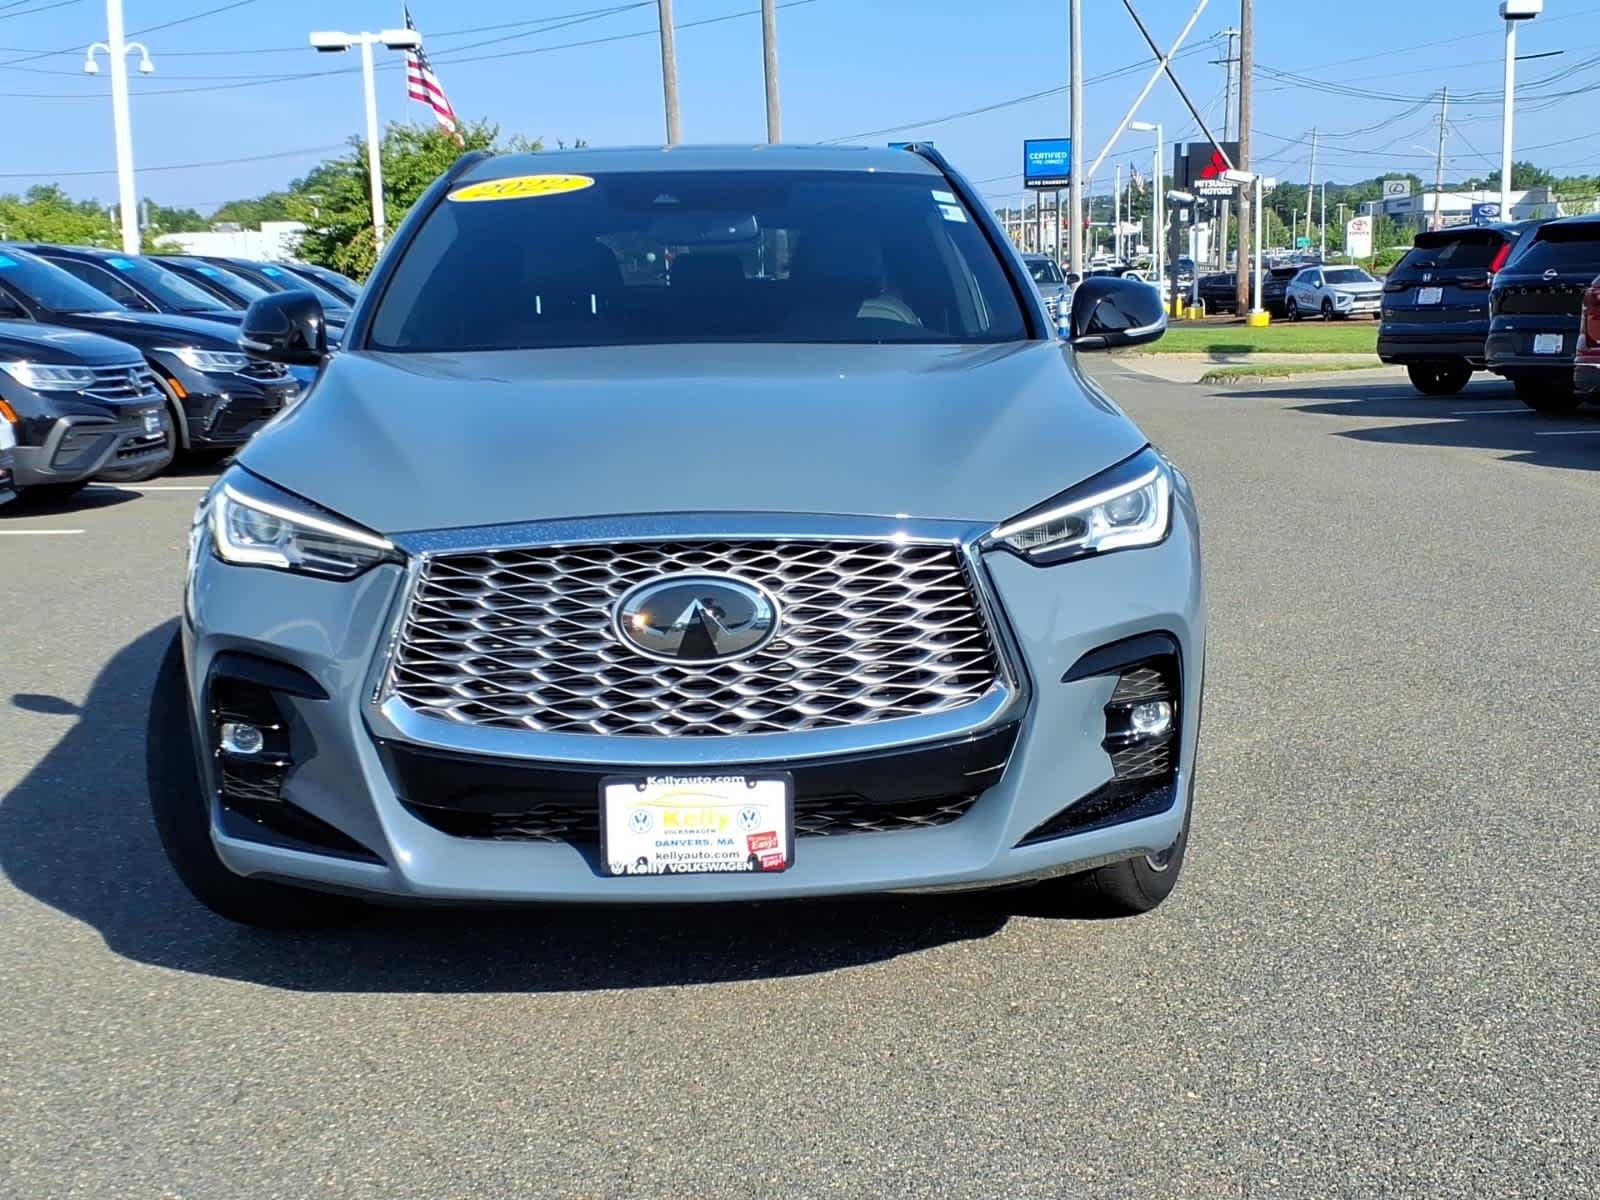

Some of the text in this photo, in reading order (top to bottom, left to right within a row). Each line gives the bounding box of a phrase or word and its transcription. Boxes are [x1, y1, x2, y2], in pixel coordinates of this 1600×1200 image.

[1029, 151, 1067, 160] CERTIFIED
[472, 176, 571, 197] 2022
[1200, 187, 1232, 195] MOTORS
[647, 776, 745, 786] Kellyauto.com
[663, 810, 729, 832] Kelly
[655, 838, 735, 847] DANVERS, MA
[656, 851, 740, 862] kellyauto.com
[627, 862, 753, 874] Kelly VOLKSWAGEN
